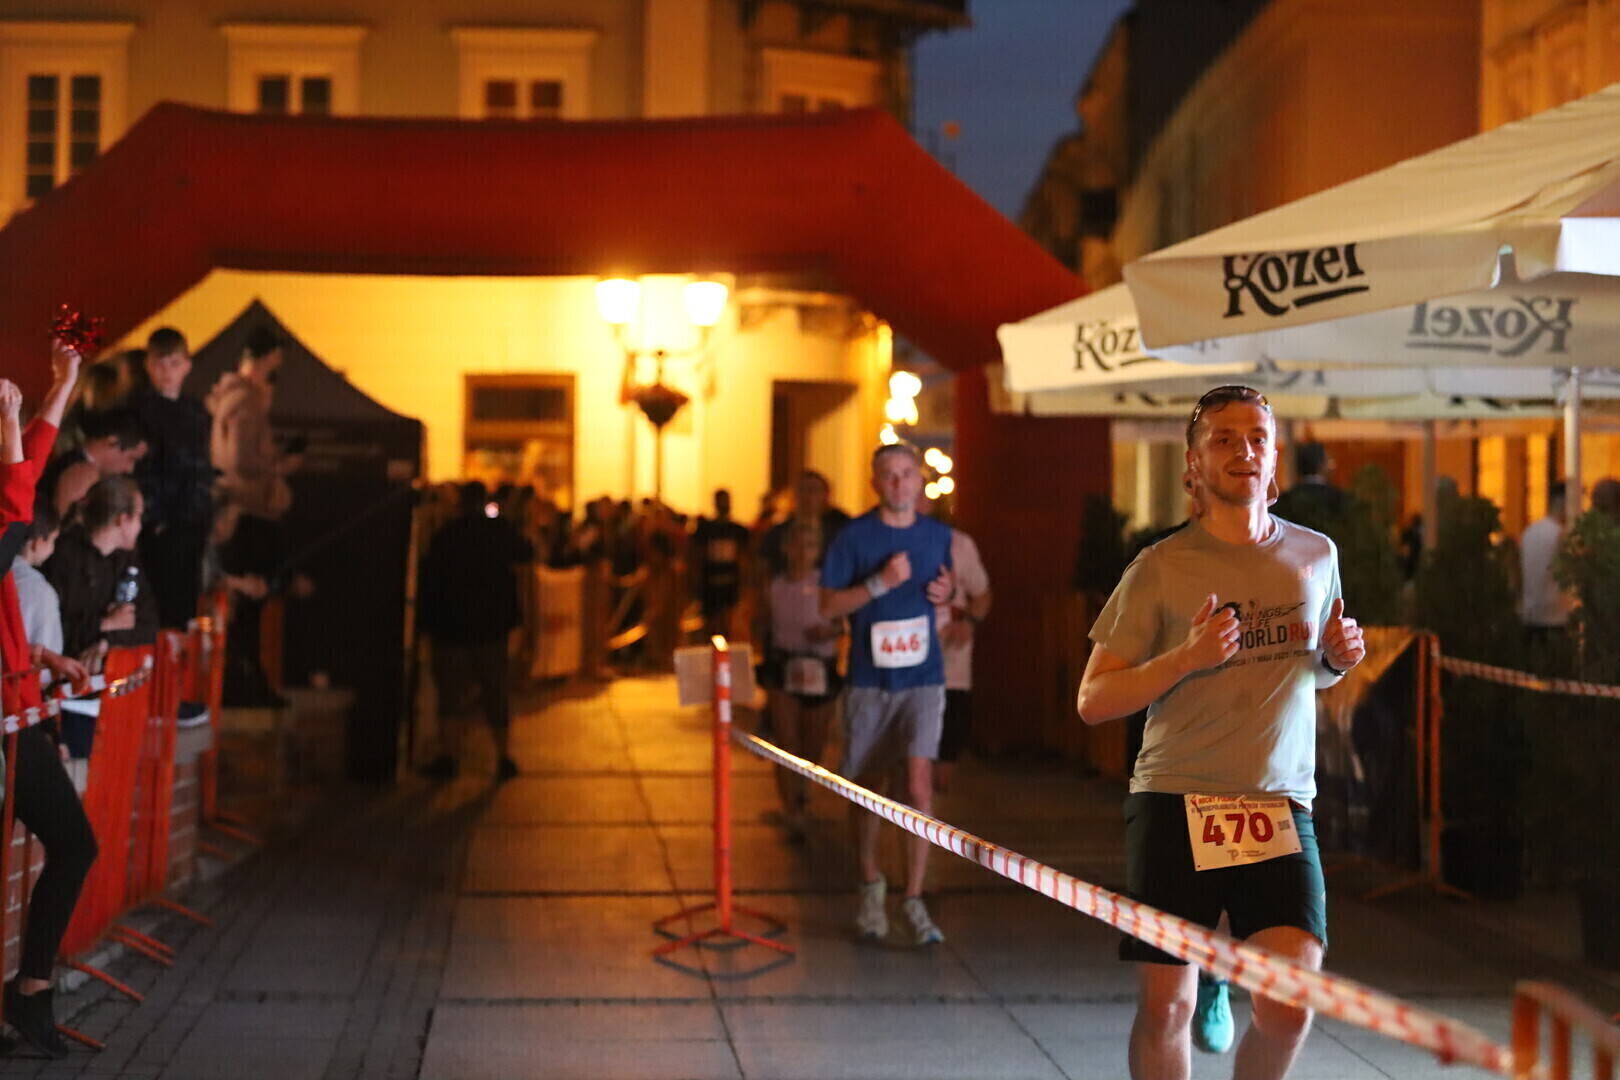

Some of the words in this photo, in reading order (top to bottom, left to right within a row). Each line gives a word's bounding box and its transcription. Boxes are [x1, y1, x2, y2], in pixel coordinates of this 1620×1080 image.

[1223, 242, 1365, 318] Kozel
[1074, 322, 1136, 371] Koz
[881, 633, 921, 654] 446
[1202, 811, 1274, 847] 470
